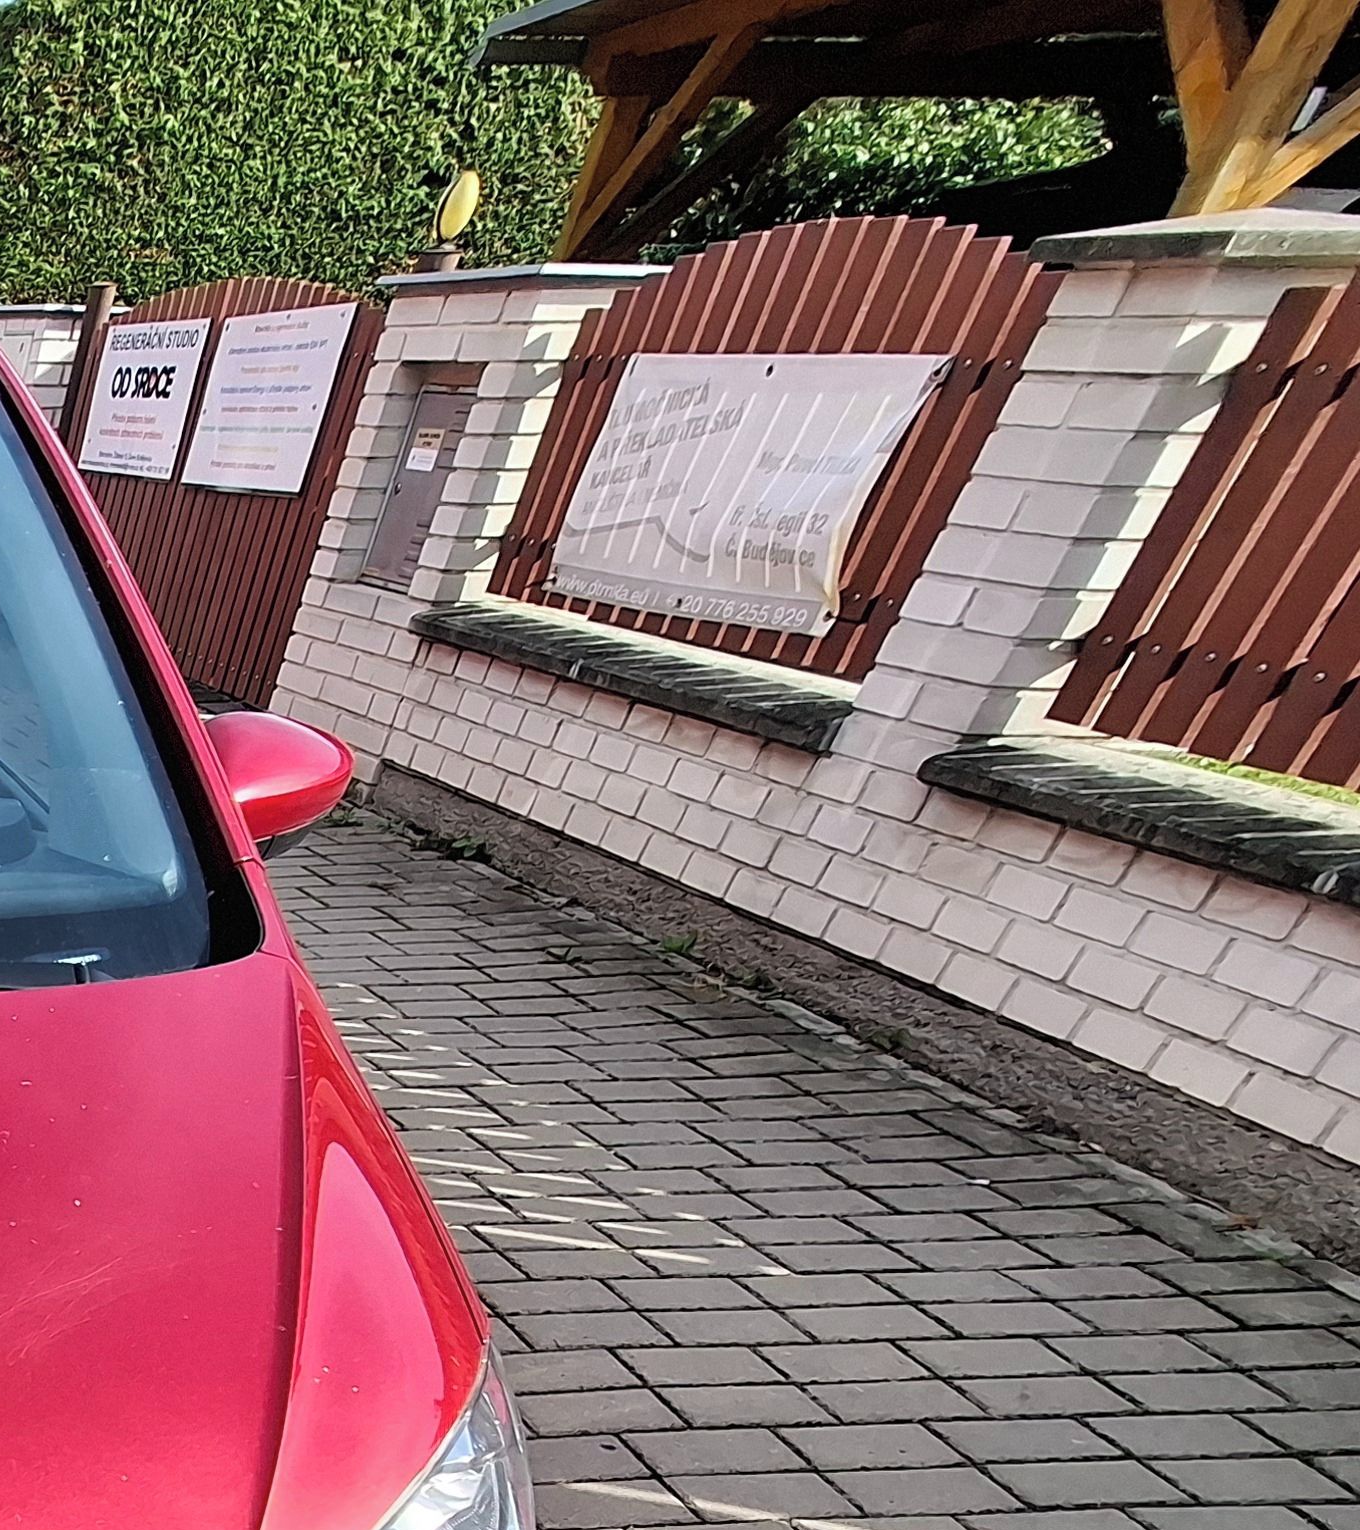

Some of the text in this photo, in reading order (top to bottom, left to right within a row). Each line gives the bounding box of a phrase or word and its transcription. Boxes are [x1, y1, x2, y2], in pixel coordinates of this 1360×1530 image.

[109, 327, 200, 351] REGENERAČNÍ STUDIO
[111, 365, 177, 399] OD SRDCE
[770, 508, 810, 538] egií
[805, 511, 830, 536] 32
[740, 539, 816, 568] Budějovce
[703, 598, 735, 620] 776
[734, 601, 771, 625] 255
[770, 605, 808, 628] 929
